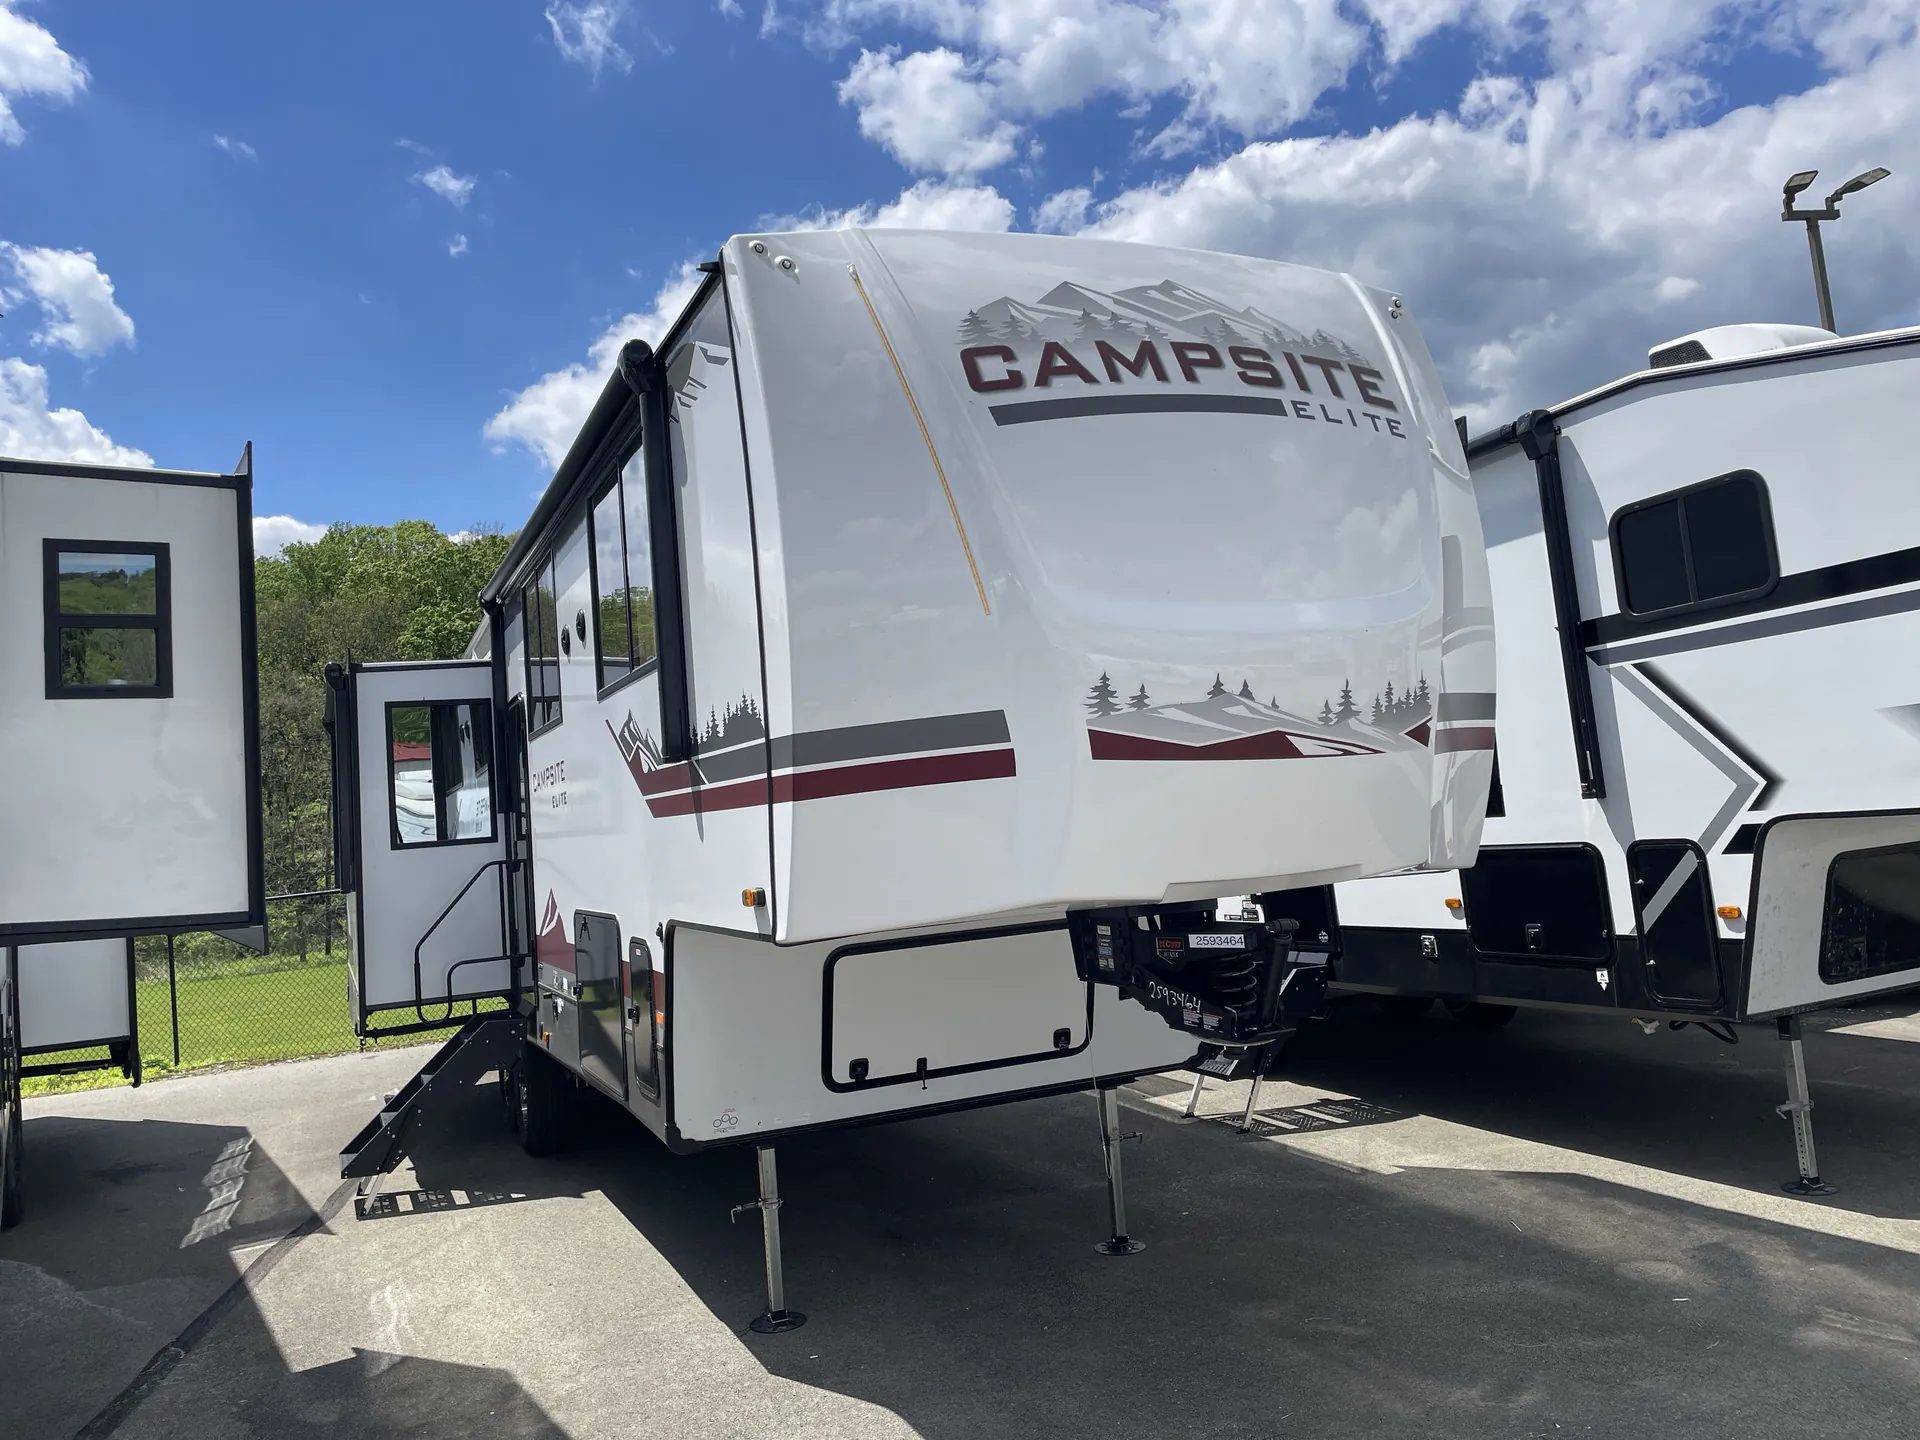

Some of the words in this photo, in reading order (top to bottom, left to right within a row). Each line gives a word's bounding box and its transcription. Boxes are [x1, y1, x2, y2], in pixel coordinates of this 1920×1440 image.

[960, 340, 1398, 411] CAMPSITE
[1294, 400, 1407, 439] ELITE
[533, 760, 565, 792] CAMPSITE
[552, 792, 567, 808] ELITE
[1195, 935, 1244, 946] 2593464
[1148, 981, 1201, 1013] 2593464
